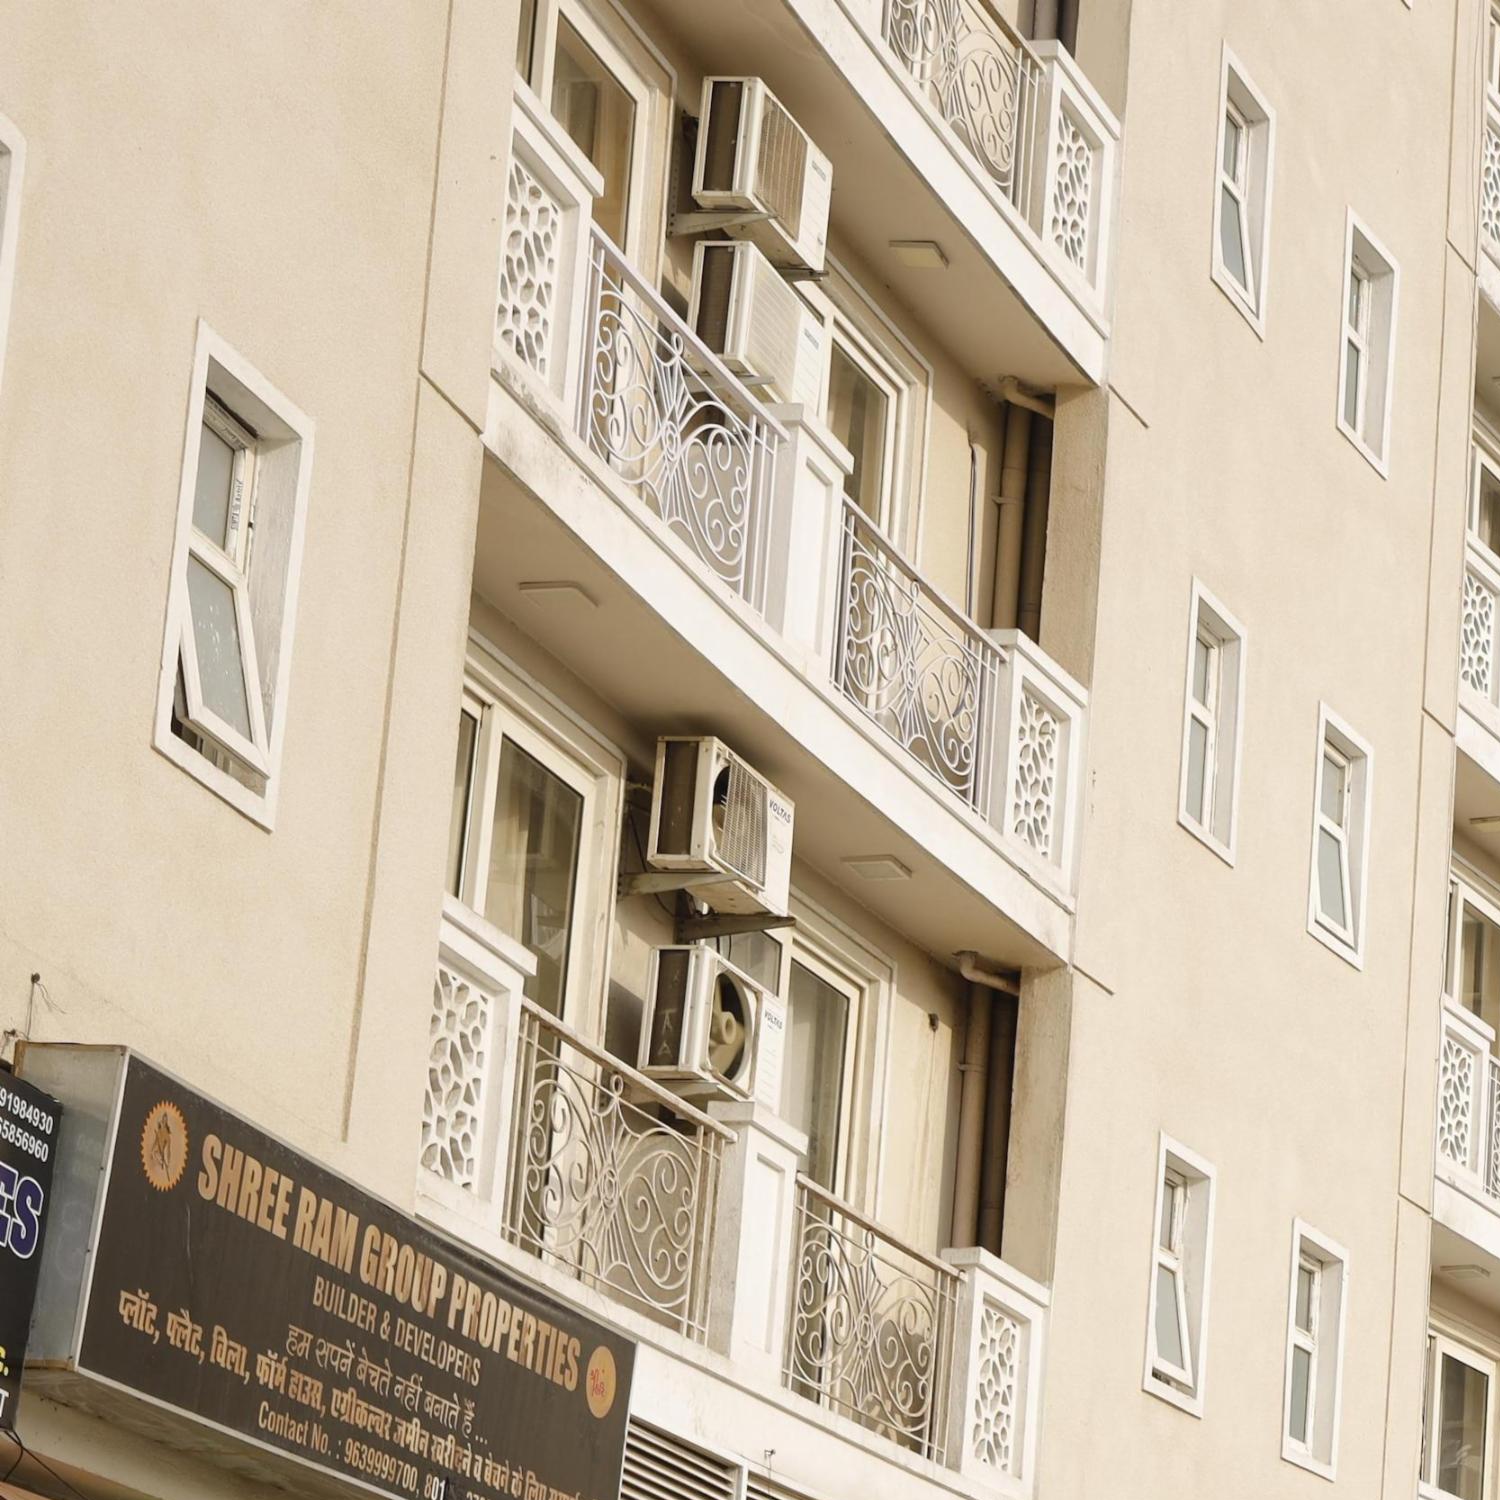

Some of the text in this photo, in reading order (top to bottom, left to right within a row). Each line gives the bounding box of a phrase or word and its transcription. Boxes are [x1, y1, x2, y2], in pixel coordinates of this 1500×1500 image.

[768, 799, 792, 824] VOLTAS
[198, 1134, 582, 1392] SHREE RAM GROUP PROPERTIES
[285, 1323, 314, 1361] हम
[356, 1347, 393, 1399] बेचते
[392, 1373, 423, 1413] नहीं
[423, 1393, 461, 1430] बनाते
[312, 1275, 482, 1388] BUILDER & DEVELOPERS
[258, 1400, 309, 1451] Contact
[311, 1421, 332, 1457] No.
